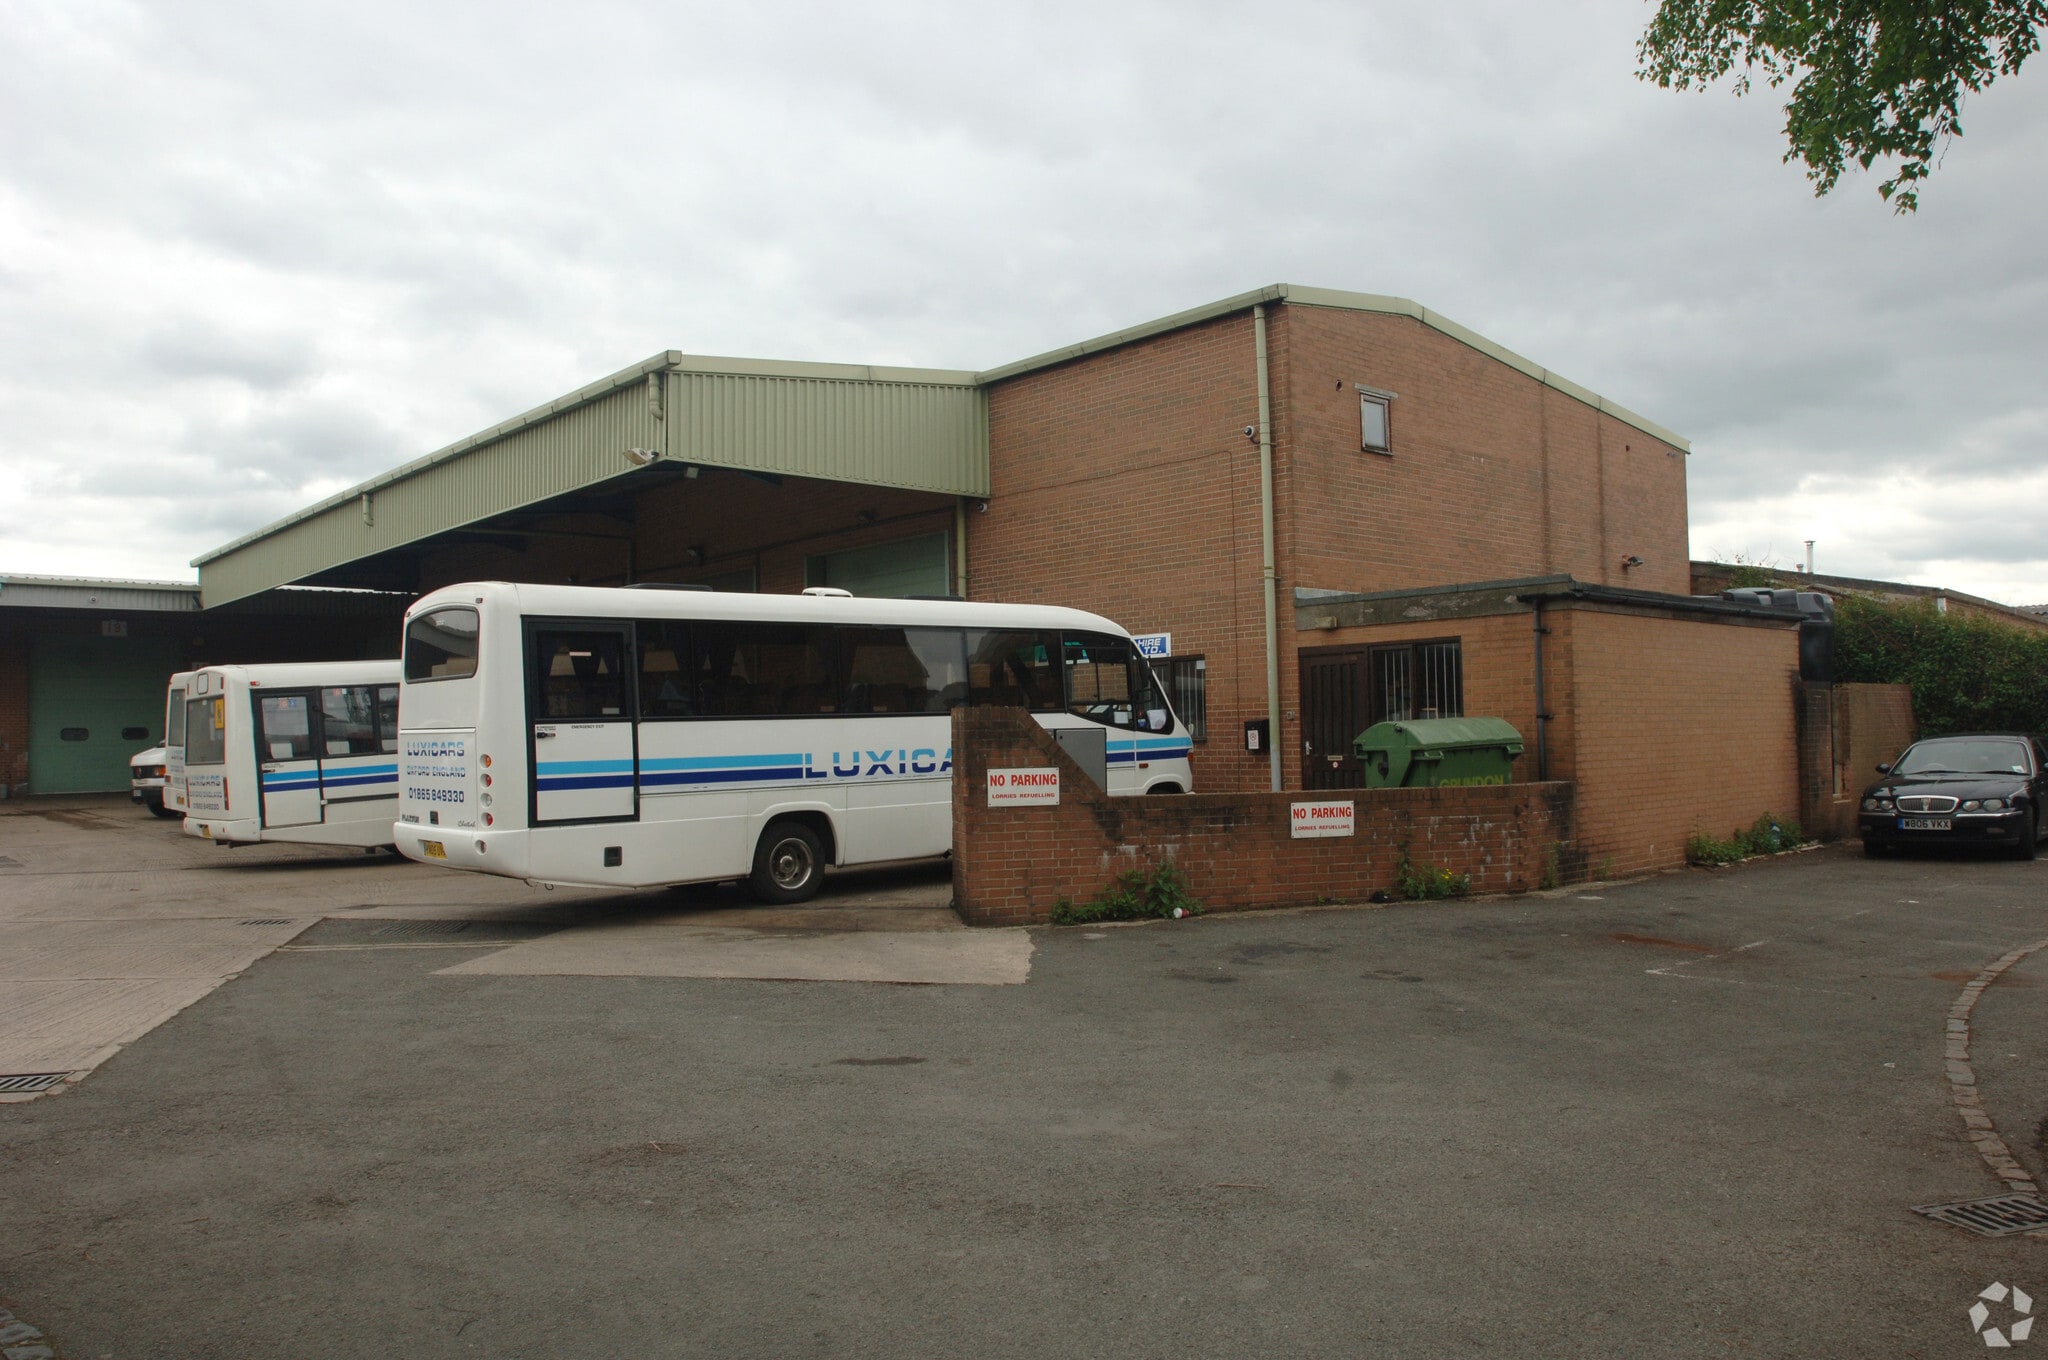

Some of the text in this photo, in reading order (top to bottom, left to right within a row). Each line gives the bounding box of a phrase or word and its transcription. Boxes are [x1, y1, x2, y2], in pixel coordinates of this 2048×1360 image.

[1137, 638, 1161, 647] HIRE
[407, 741, 465, 757] LUXICARS
[407, 765, 466, 778] OXFORD ENGLAND
[989, 773, 1057, 787] NO PARKING
[408, 787, 465, 803] 01865 849330
[1293, 806, 1352, 820] NO PARKING
[1904, 819, 1950, 829] W806 VKX
